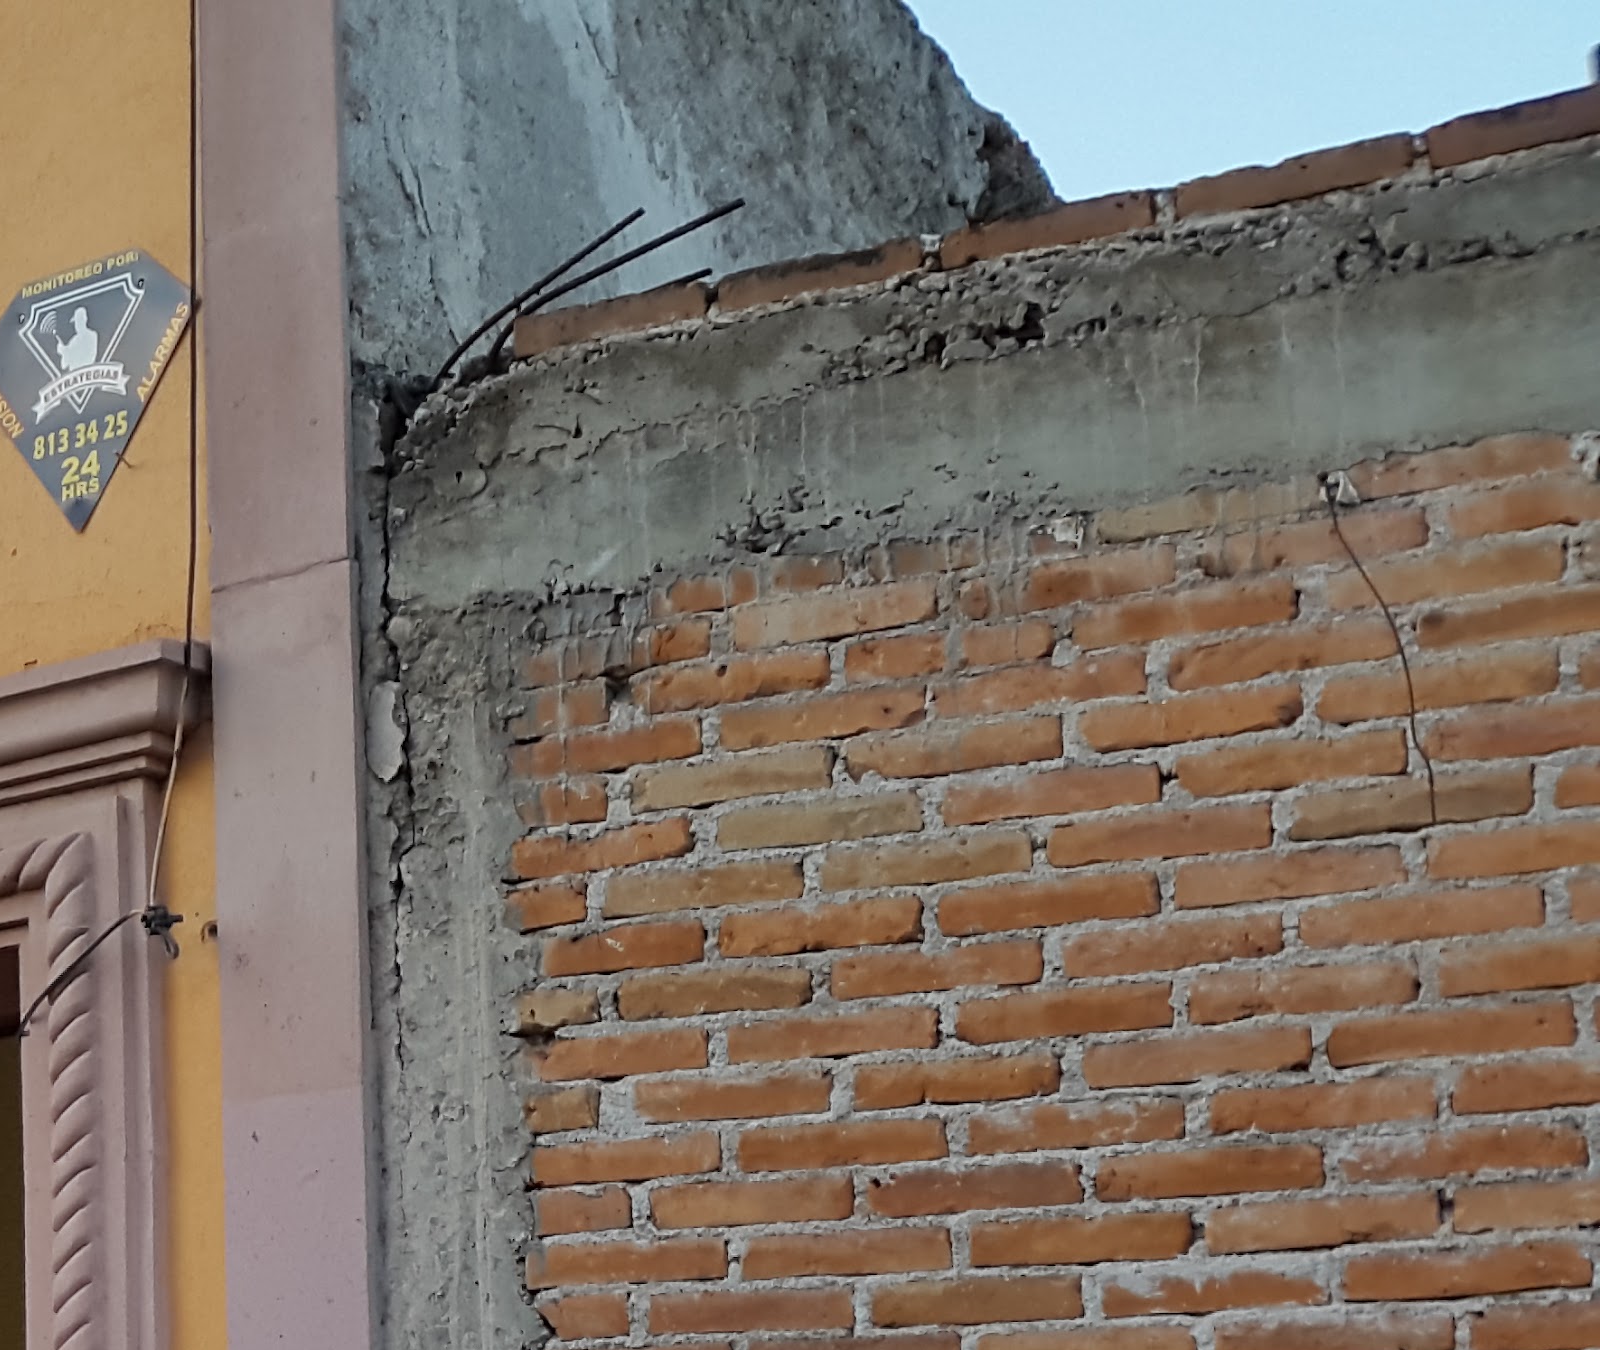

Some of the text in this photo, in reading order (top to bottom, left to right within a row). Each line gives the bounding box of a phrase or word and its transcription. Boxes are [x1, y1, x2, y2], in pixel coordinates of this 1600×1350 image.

[21, 262, 104, 299] MONITOREO
[136, 301, 189, 403] ALARMAS
[42, 368, 120, 403] ESTRATEGIAS
[33, 410, 129, 460] 813 34 25
[60, 450, 100, 485] 24
[61, 477, 100, 502] HRS
